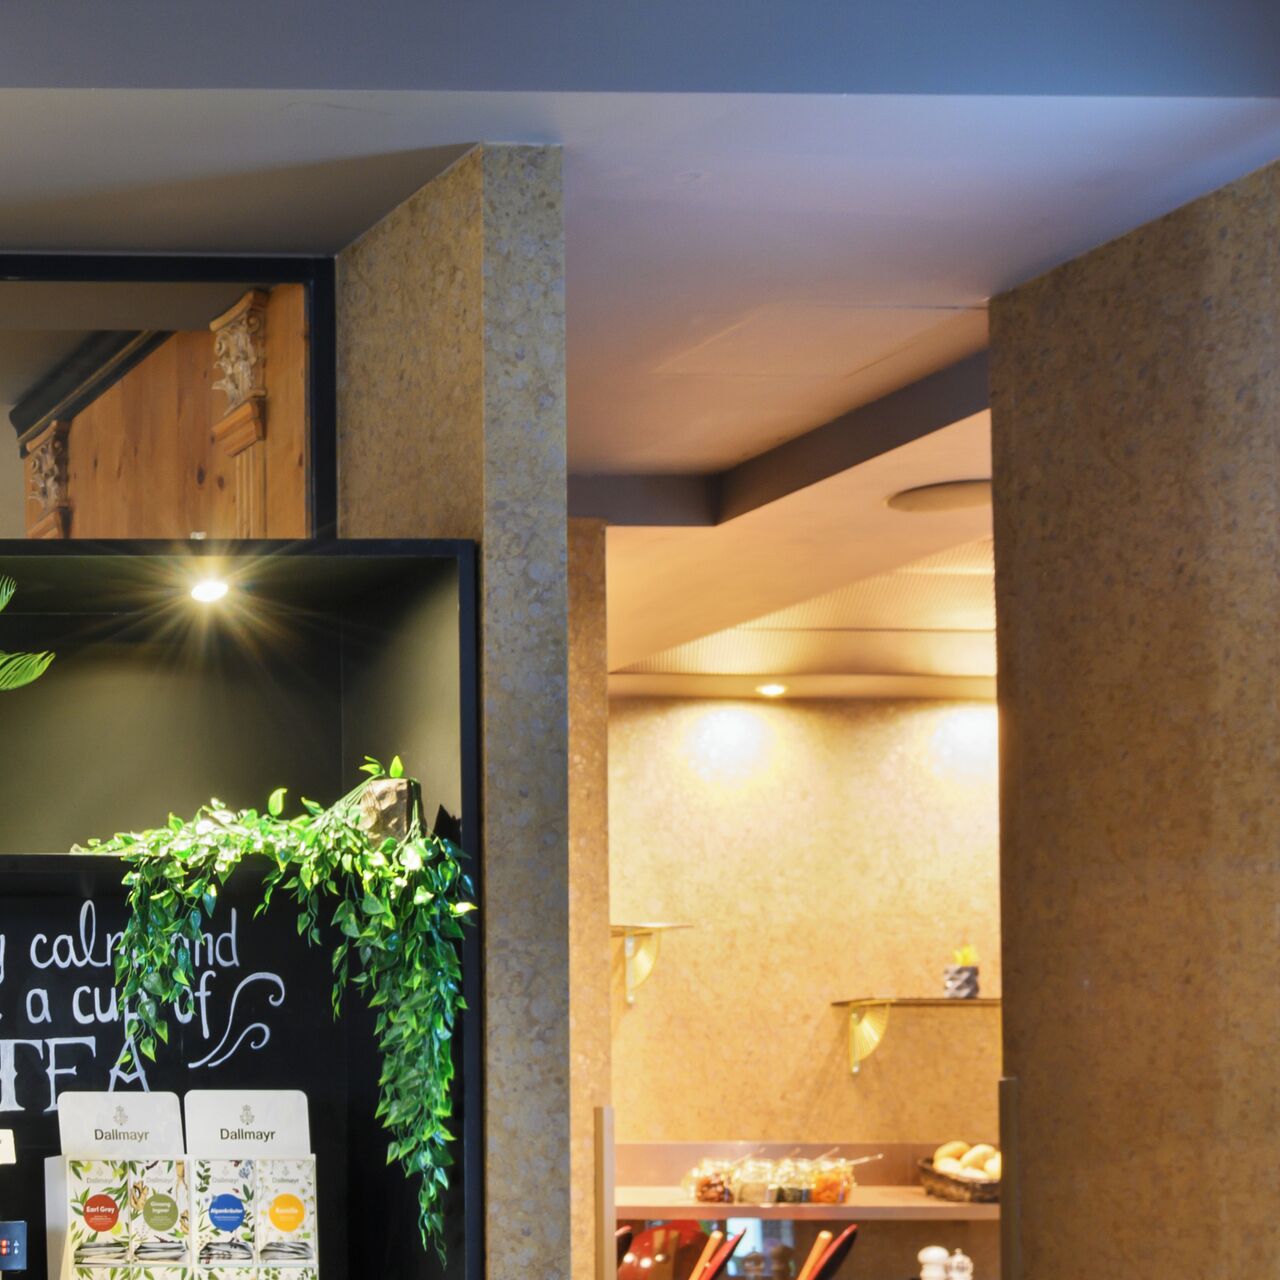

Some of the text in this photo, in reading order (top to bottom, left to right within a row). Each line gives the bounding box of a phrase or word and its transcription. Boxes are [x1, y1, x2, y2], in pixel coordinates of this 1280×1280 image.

[26, 988, 52, 1023] a
[94, 1129, 150, 1143] Dallmayr
[220, 1128, 276, 1142] Dallmayr
[99, 1206, 115, 1214] Grey
